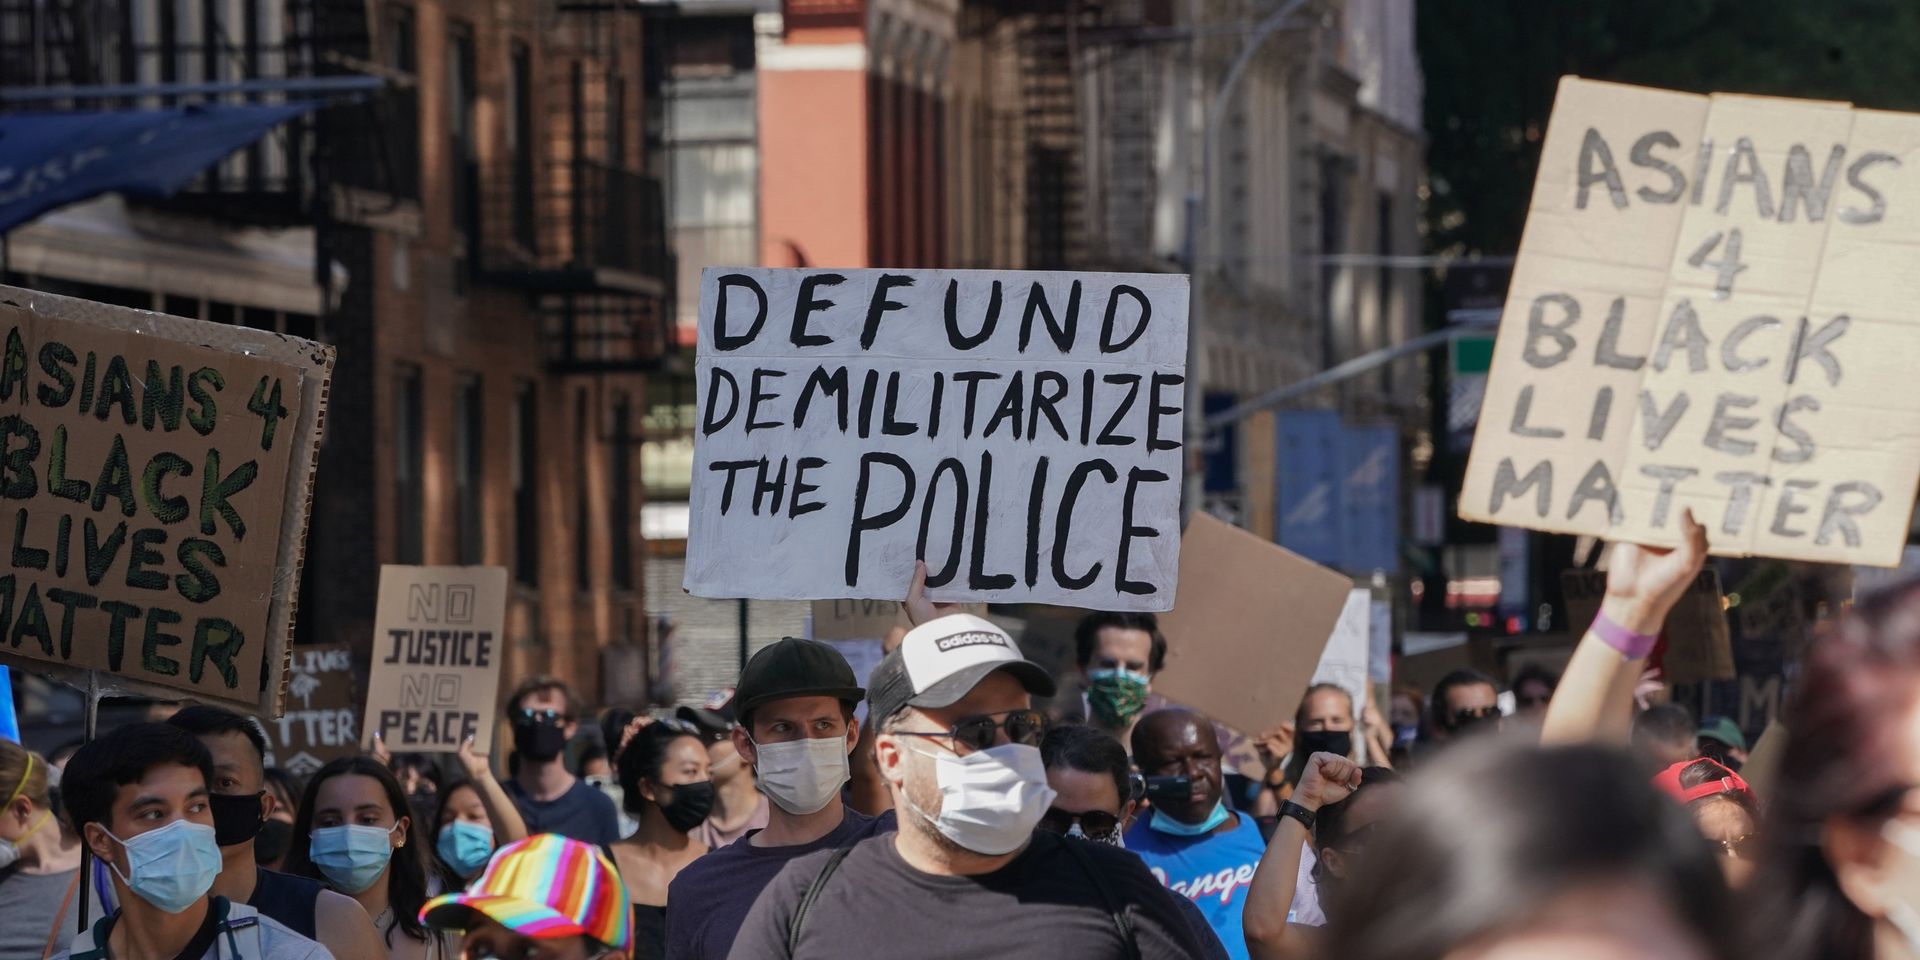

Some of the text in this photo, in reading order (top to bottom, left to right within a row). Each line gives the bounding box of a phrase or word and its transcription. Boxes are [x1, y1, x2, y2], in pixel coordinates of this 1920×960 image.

[1574, 126, 1903, 226] ASIANS
[1687, 227, 1749, 300] 4
[713, 273, 1152, 354] DEFUND
[1521, 292, 1851, 388] BLACK
[1, 326, 289, 452] ASIANS 4
[702, 364, 1185, 456] DEMILITARIZE
[1509, 384, 1821, 464] LIVES
[0, 414, 259, 543] BLACK
[1488, 456, 1883, 548] MATTER
[11, 507, 228, 602] LIVES
[709, 450, 1170, 598] THE POLICE
[407, 583, 476, 625] NO
[939, 633, 990, 650] adidas
[384, 629, 493, 668] JUSTICE
[401, 673, 462, 709] NO
[380, 711, 479, 745] PEACE
